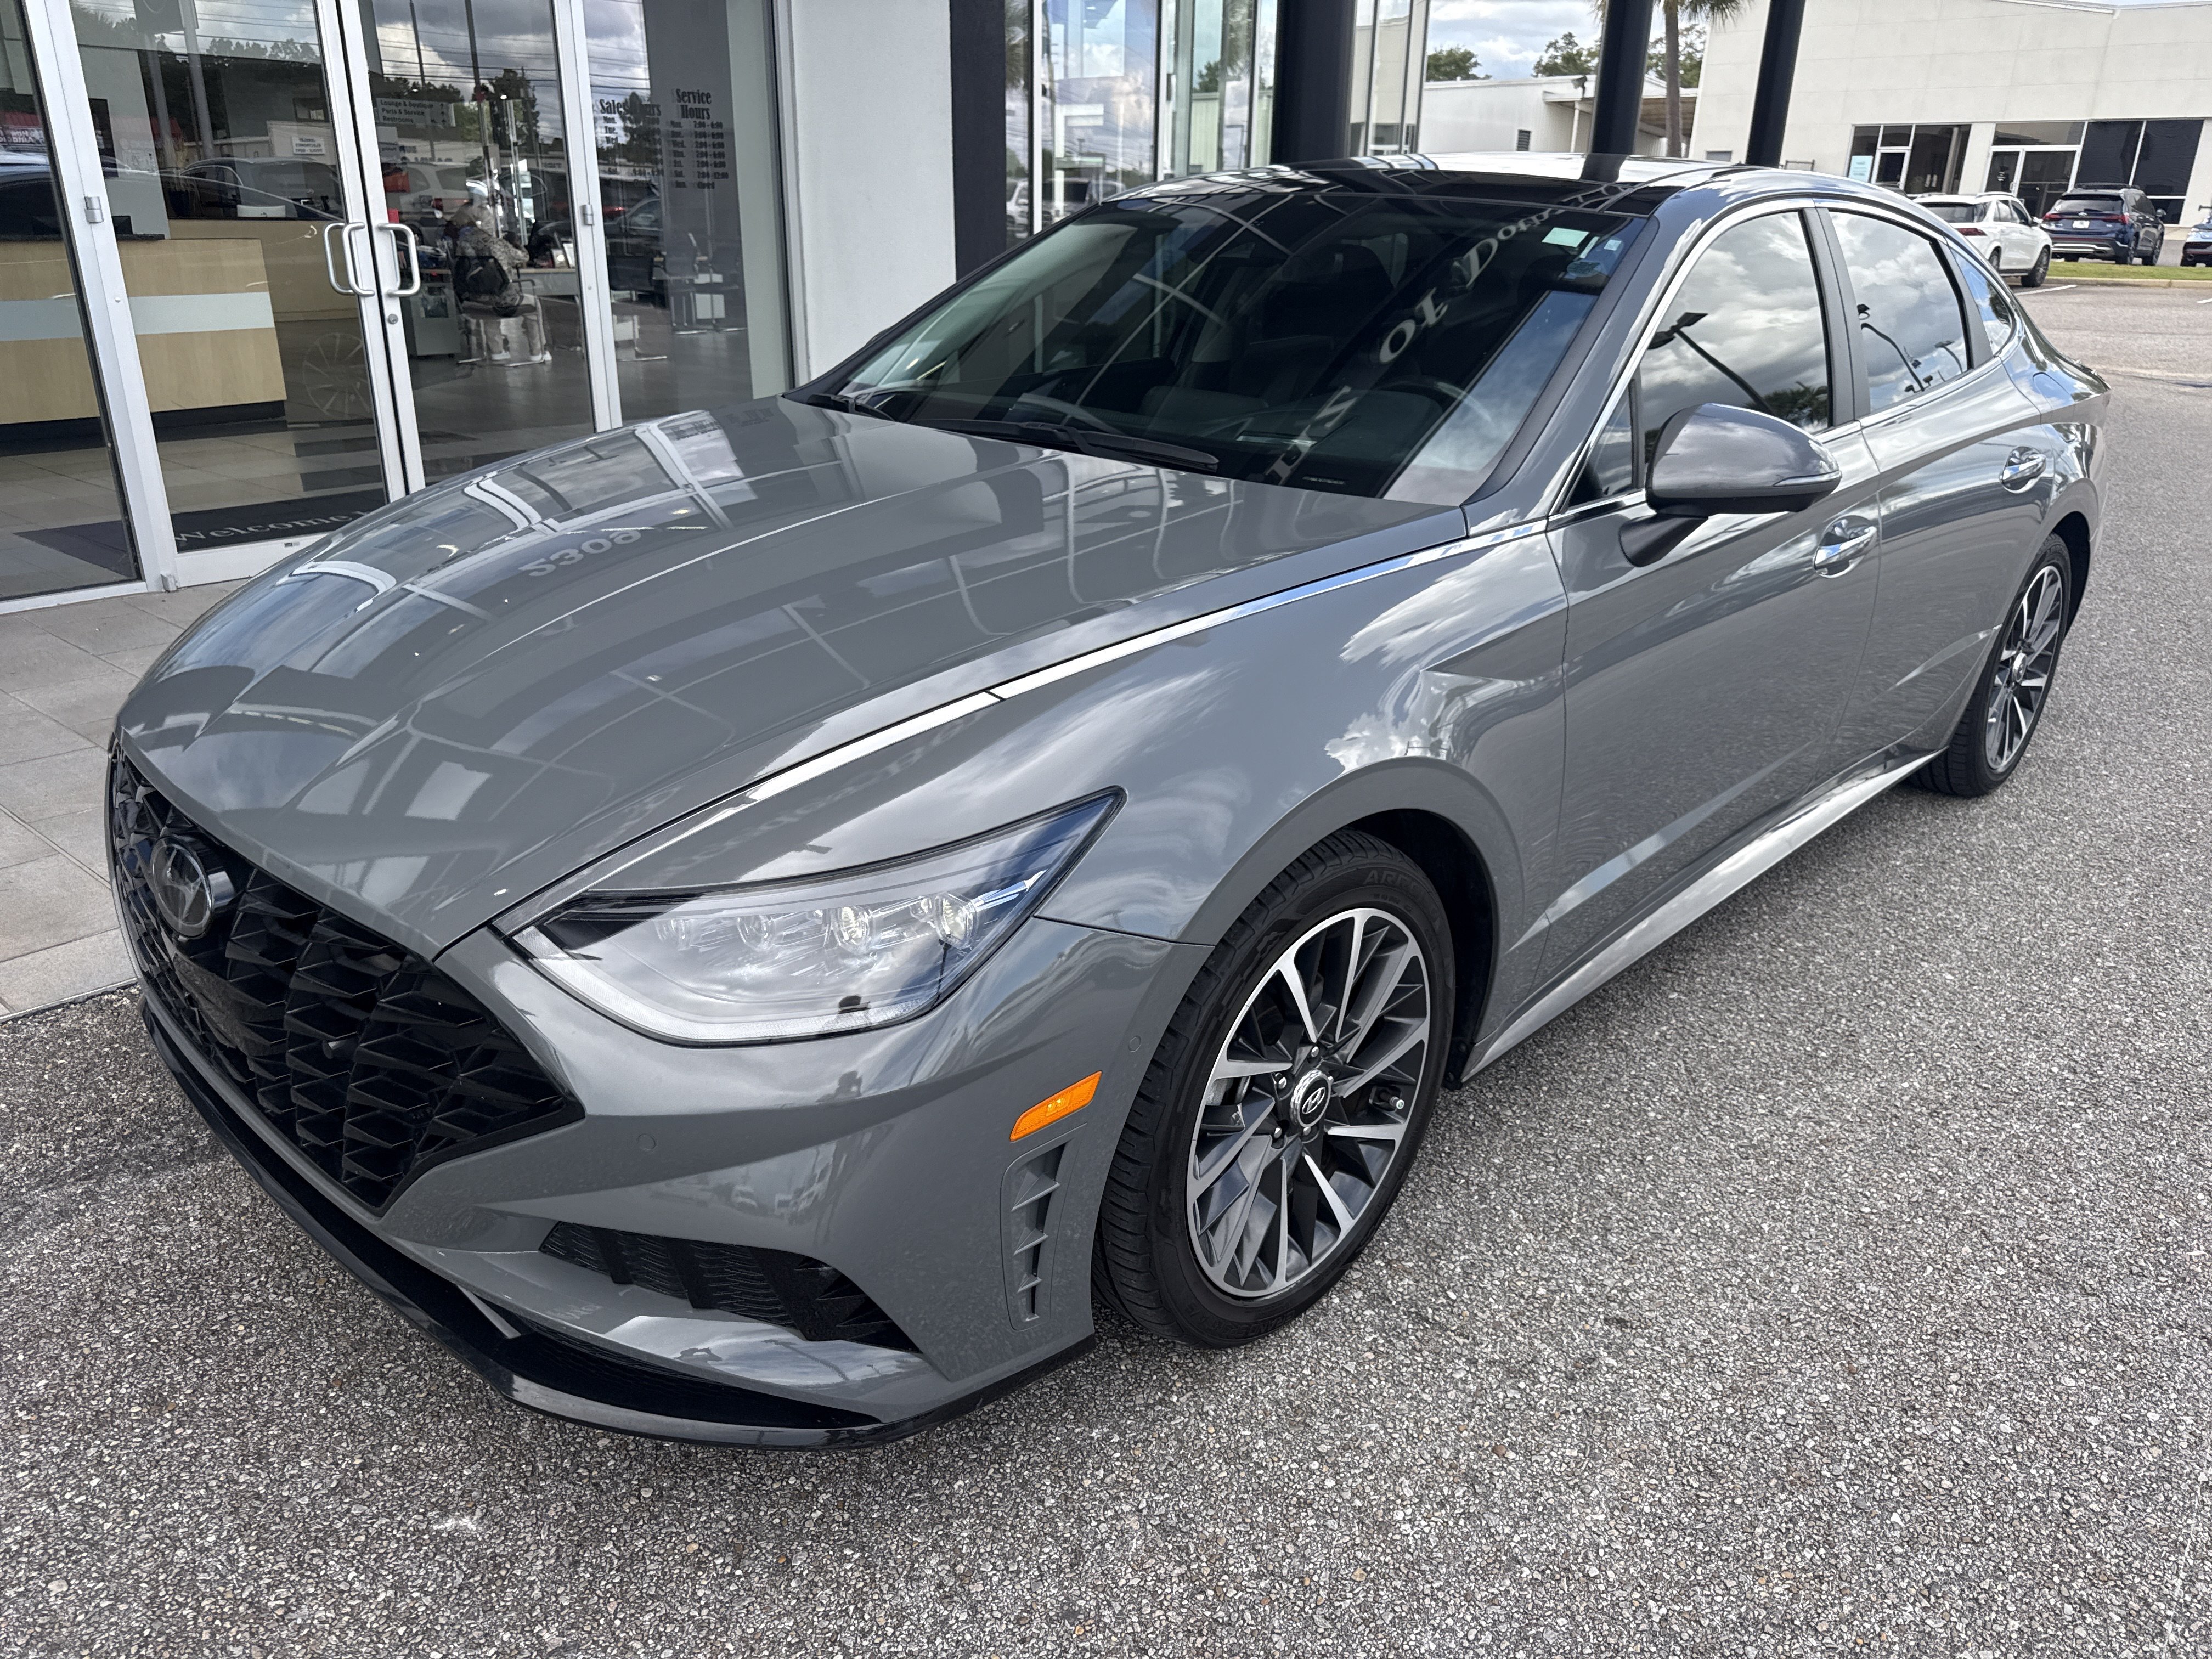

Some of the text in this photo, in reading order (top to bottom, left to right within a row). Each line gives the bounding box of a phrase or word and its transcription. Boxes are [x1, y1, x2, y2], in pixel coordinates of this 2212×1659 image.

[676, 89, 712, 104] Service
[681, 105, 710, 120] Hours
[174, 515, 353, 542] Welcome
